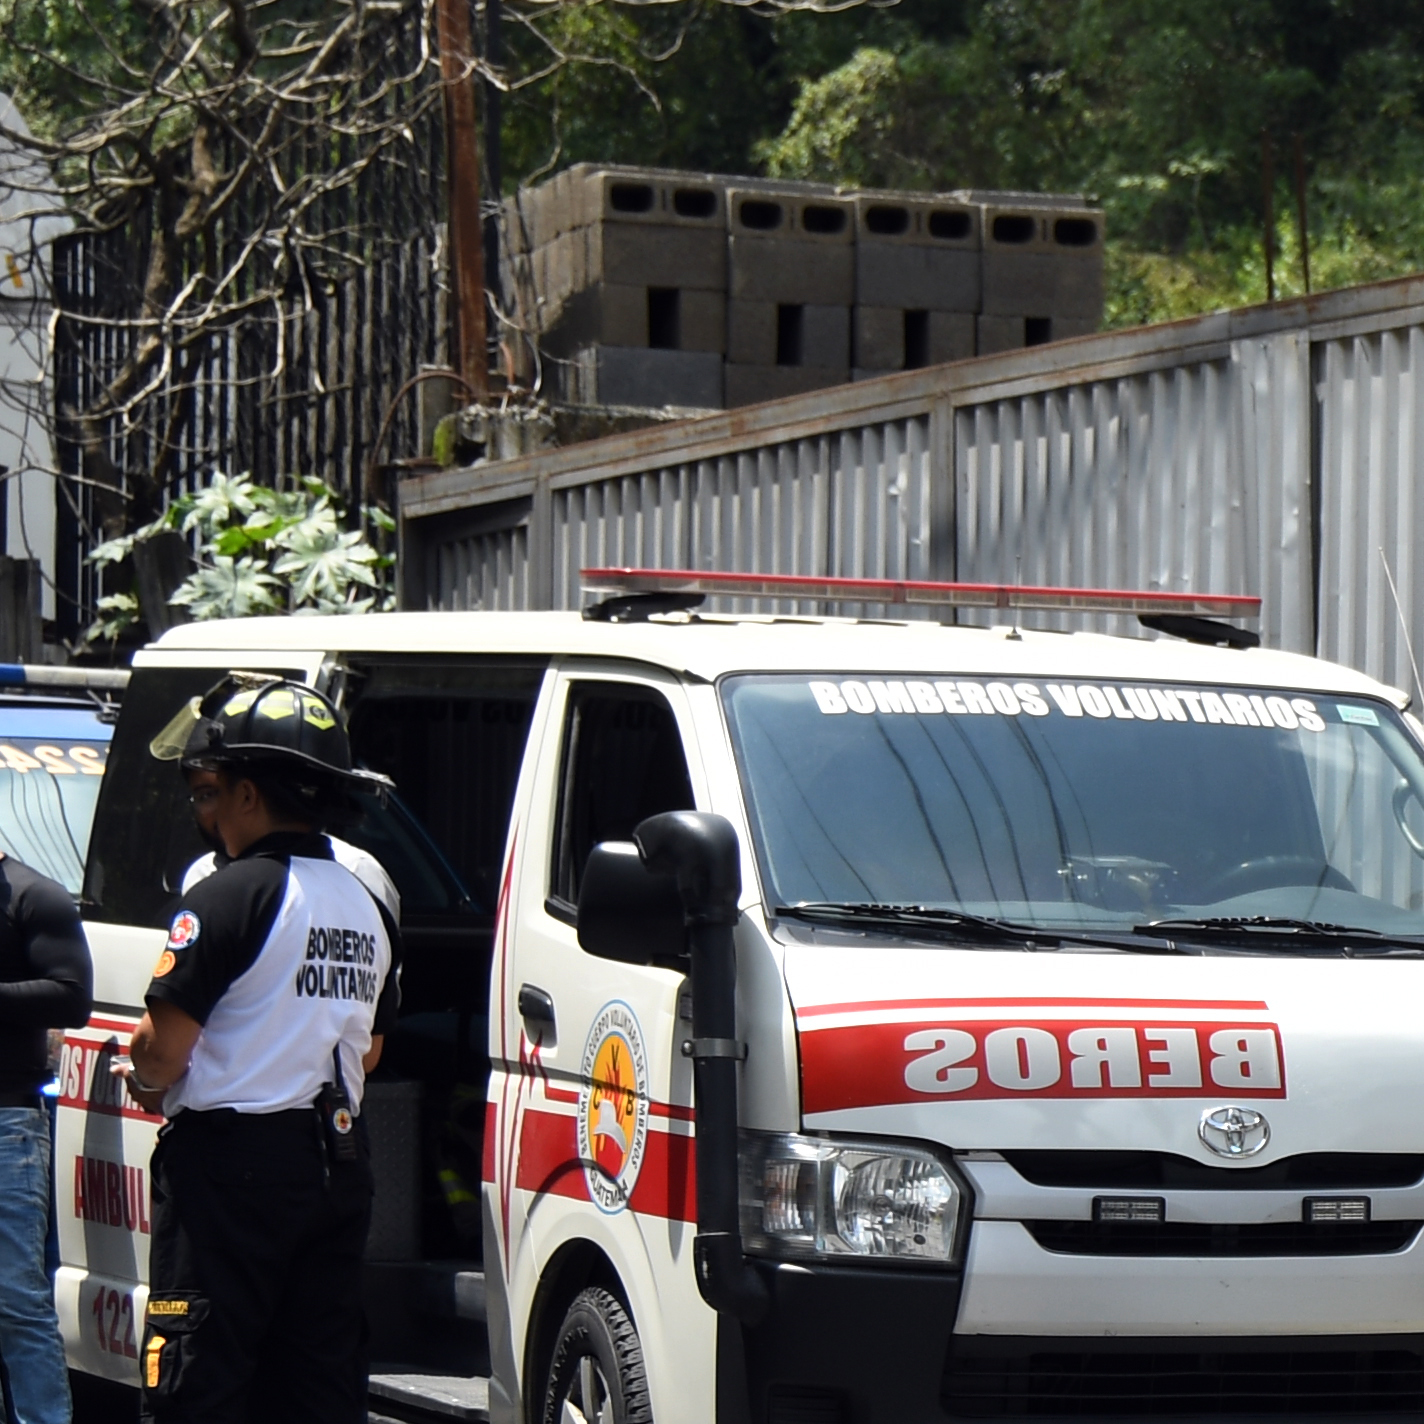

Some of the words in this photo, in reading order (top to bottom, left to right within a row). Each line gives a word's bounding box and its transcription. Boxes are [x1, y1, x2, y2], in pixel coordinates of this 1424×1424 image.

[808, 680, 1049, 716] BOMBEROS
[1046, 684, 1326, 732] VOLUNTARIOS
[306, 926, 376, 967] BOMBEROS
[93, 1286, 138, 1359] 122
